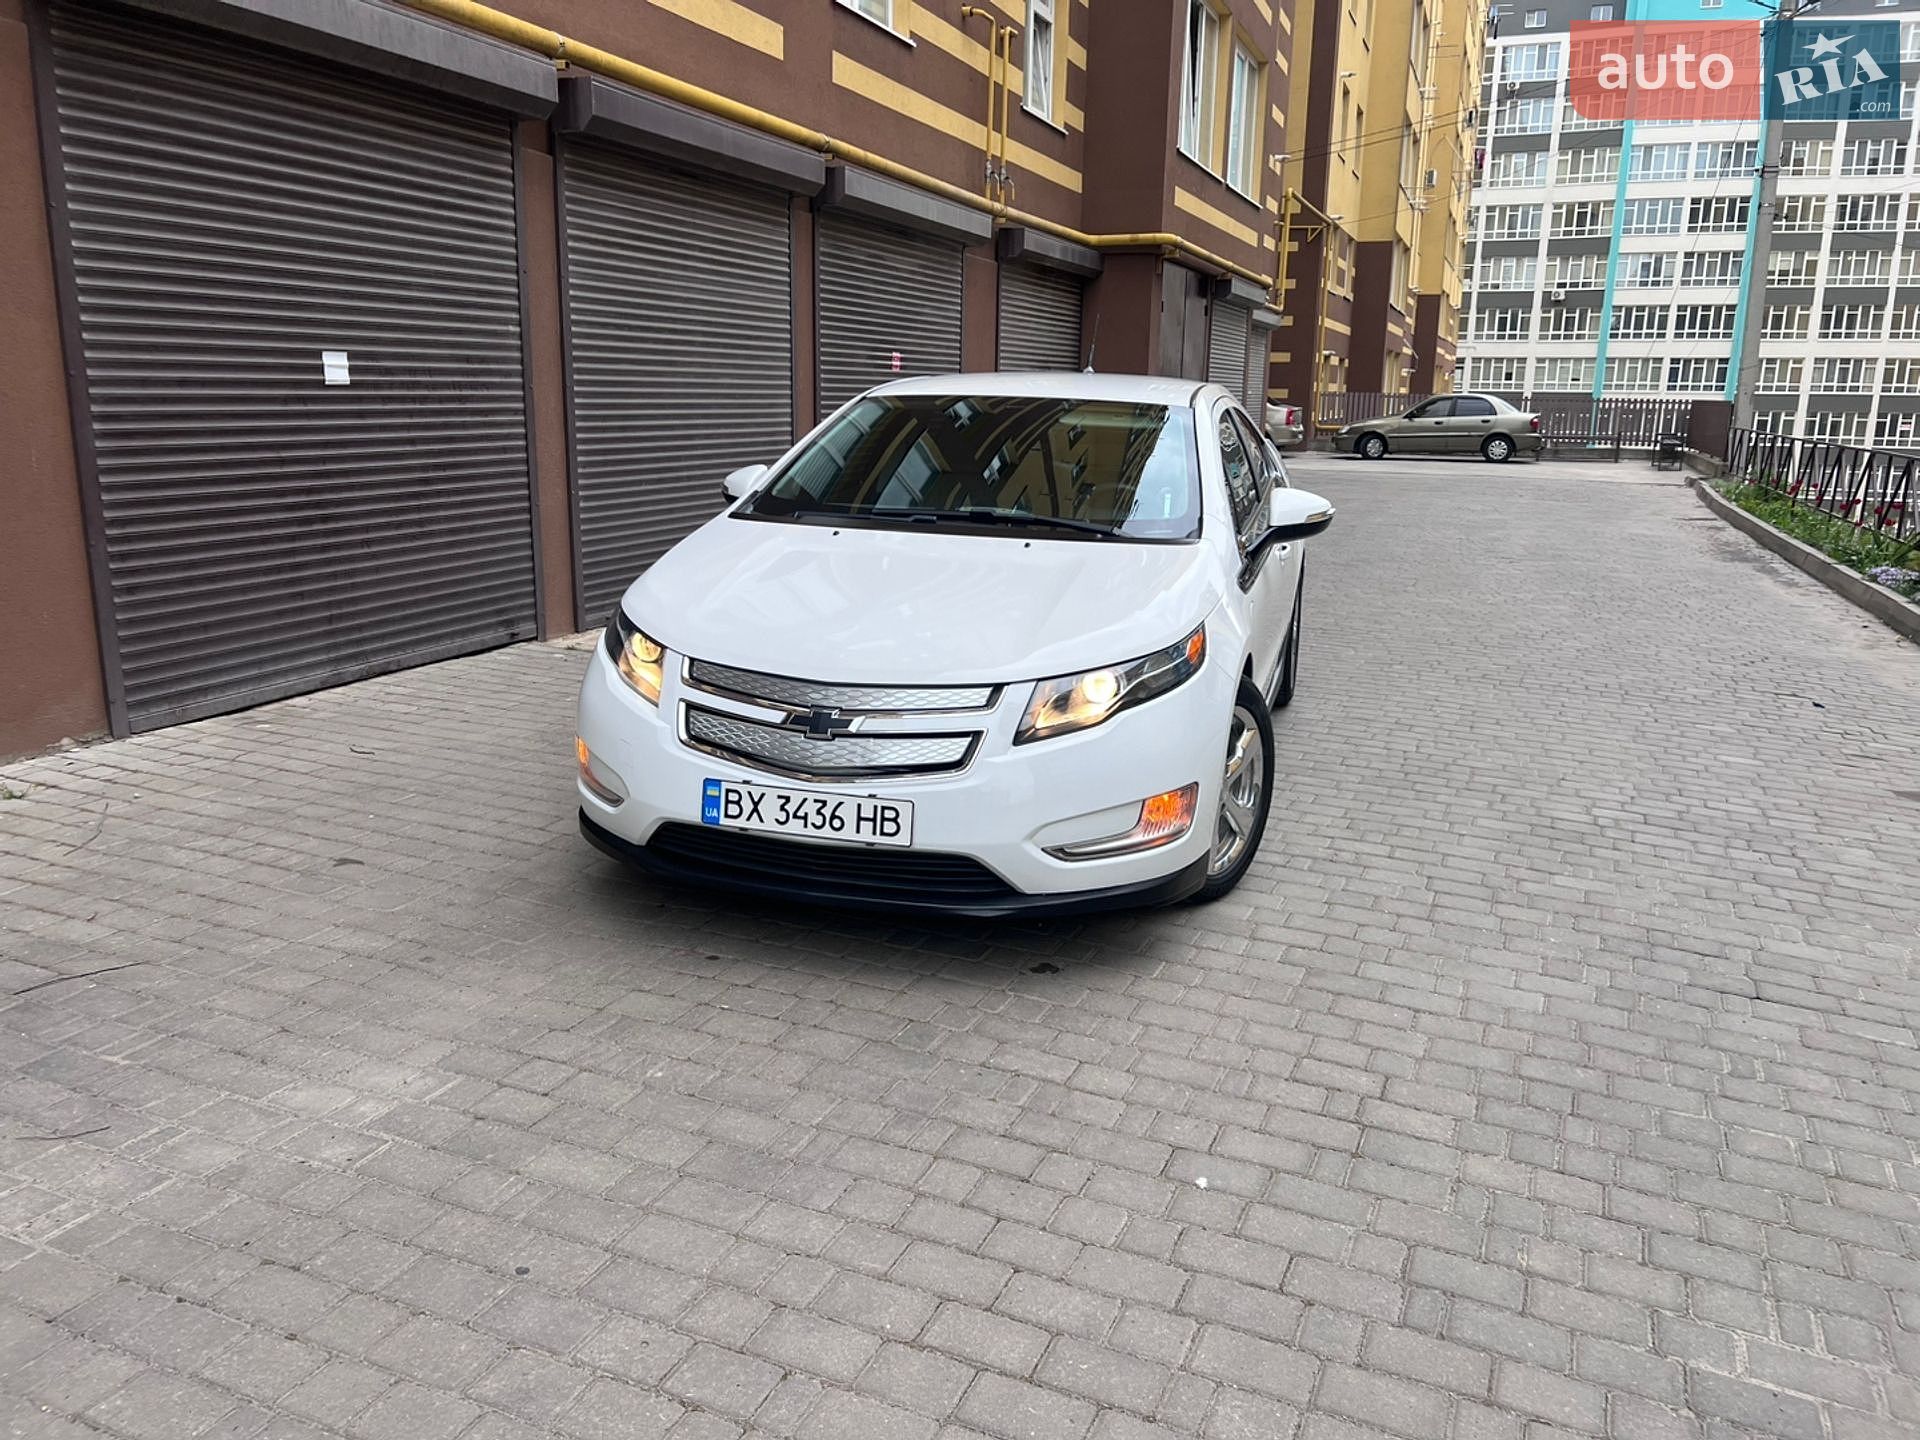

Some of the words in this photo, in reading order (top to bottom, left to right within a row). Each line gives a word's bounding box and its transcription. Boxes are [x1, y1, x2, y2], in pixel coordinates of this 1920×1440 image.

[705, 808, 719, 818] UA
[724, 788, 766, 823] BX
[774, 794, 846, 832] 3436
[855, 803, 901, 837] HB
